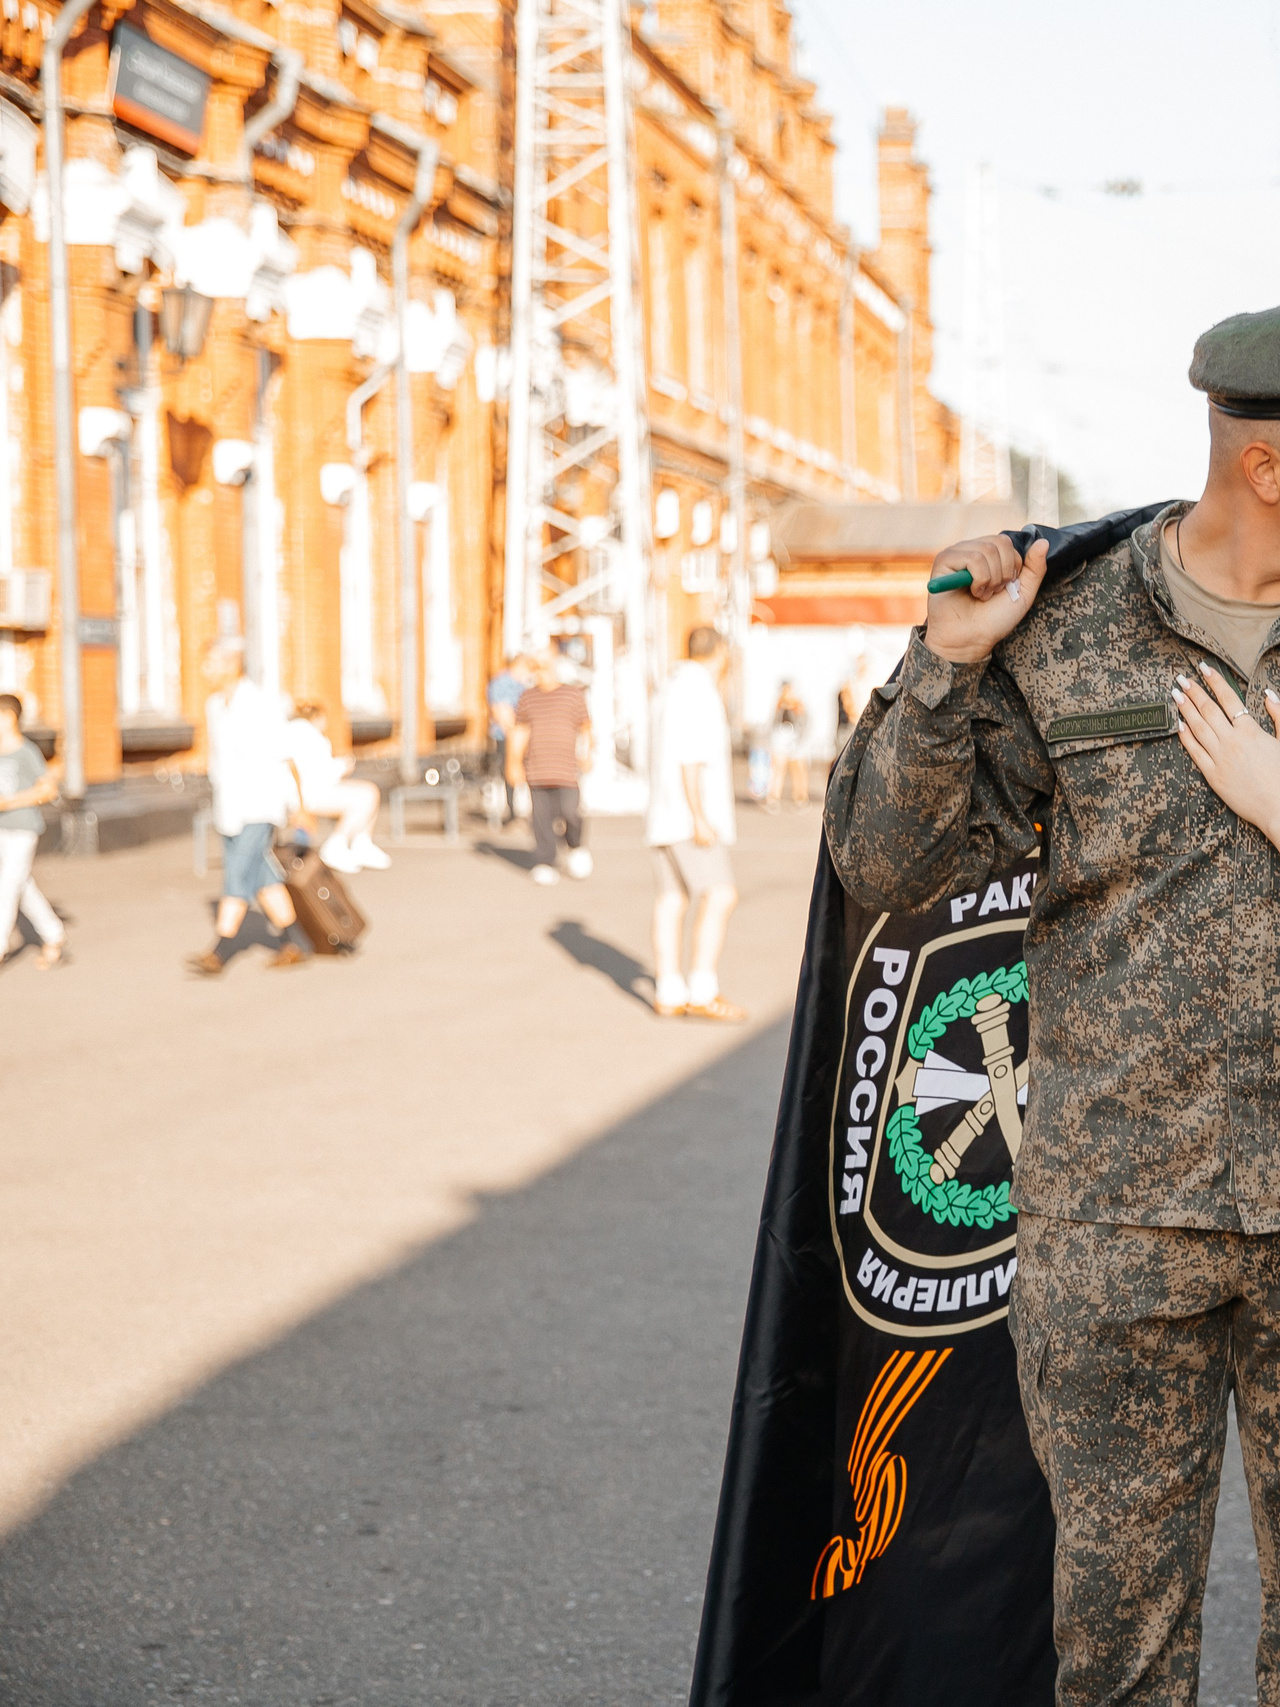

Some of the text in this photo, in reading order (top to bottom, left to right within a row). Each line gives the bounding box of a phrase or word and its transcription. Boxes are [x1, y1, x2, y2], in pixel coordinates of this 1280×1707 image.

[1109, 714, 1131, 729] СИЛЫ
[1132, 709, 1164, 727] РОССИИ
[950, 872, 1037, 924] РАК
[839, 946, 910, 1214] РОССИЯ
